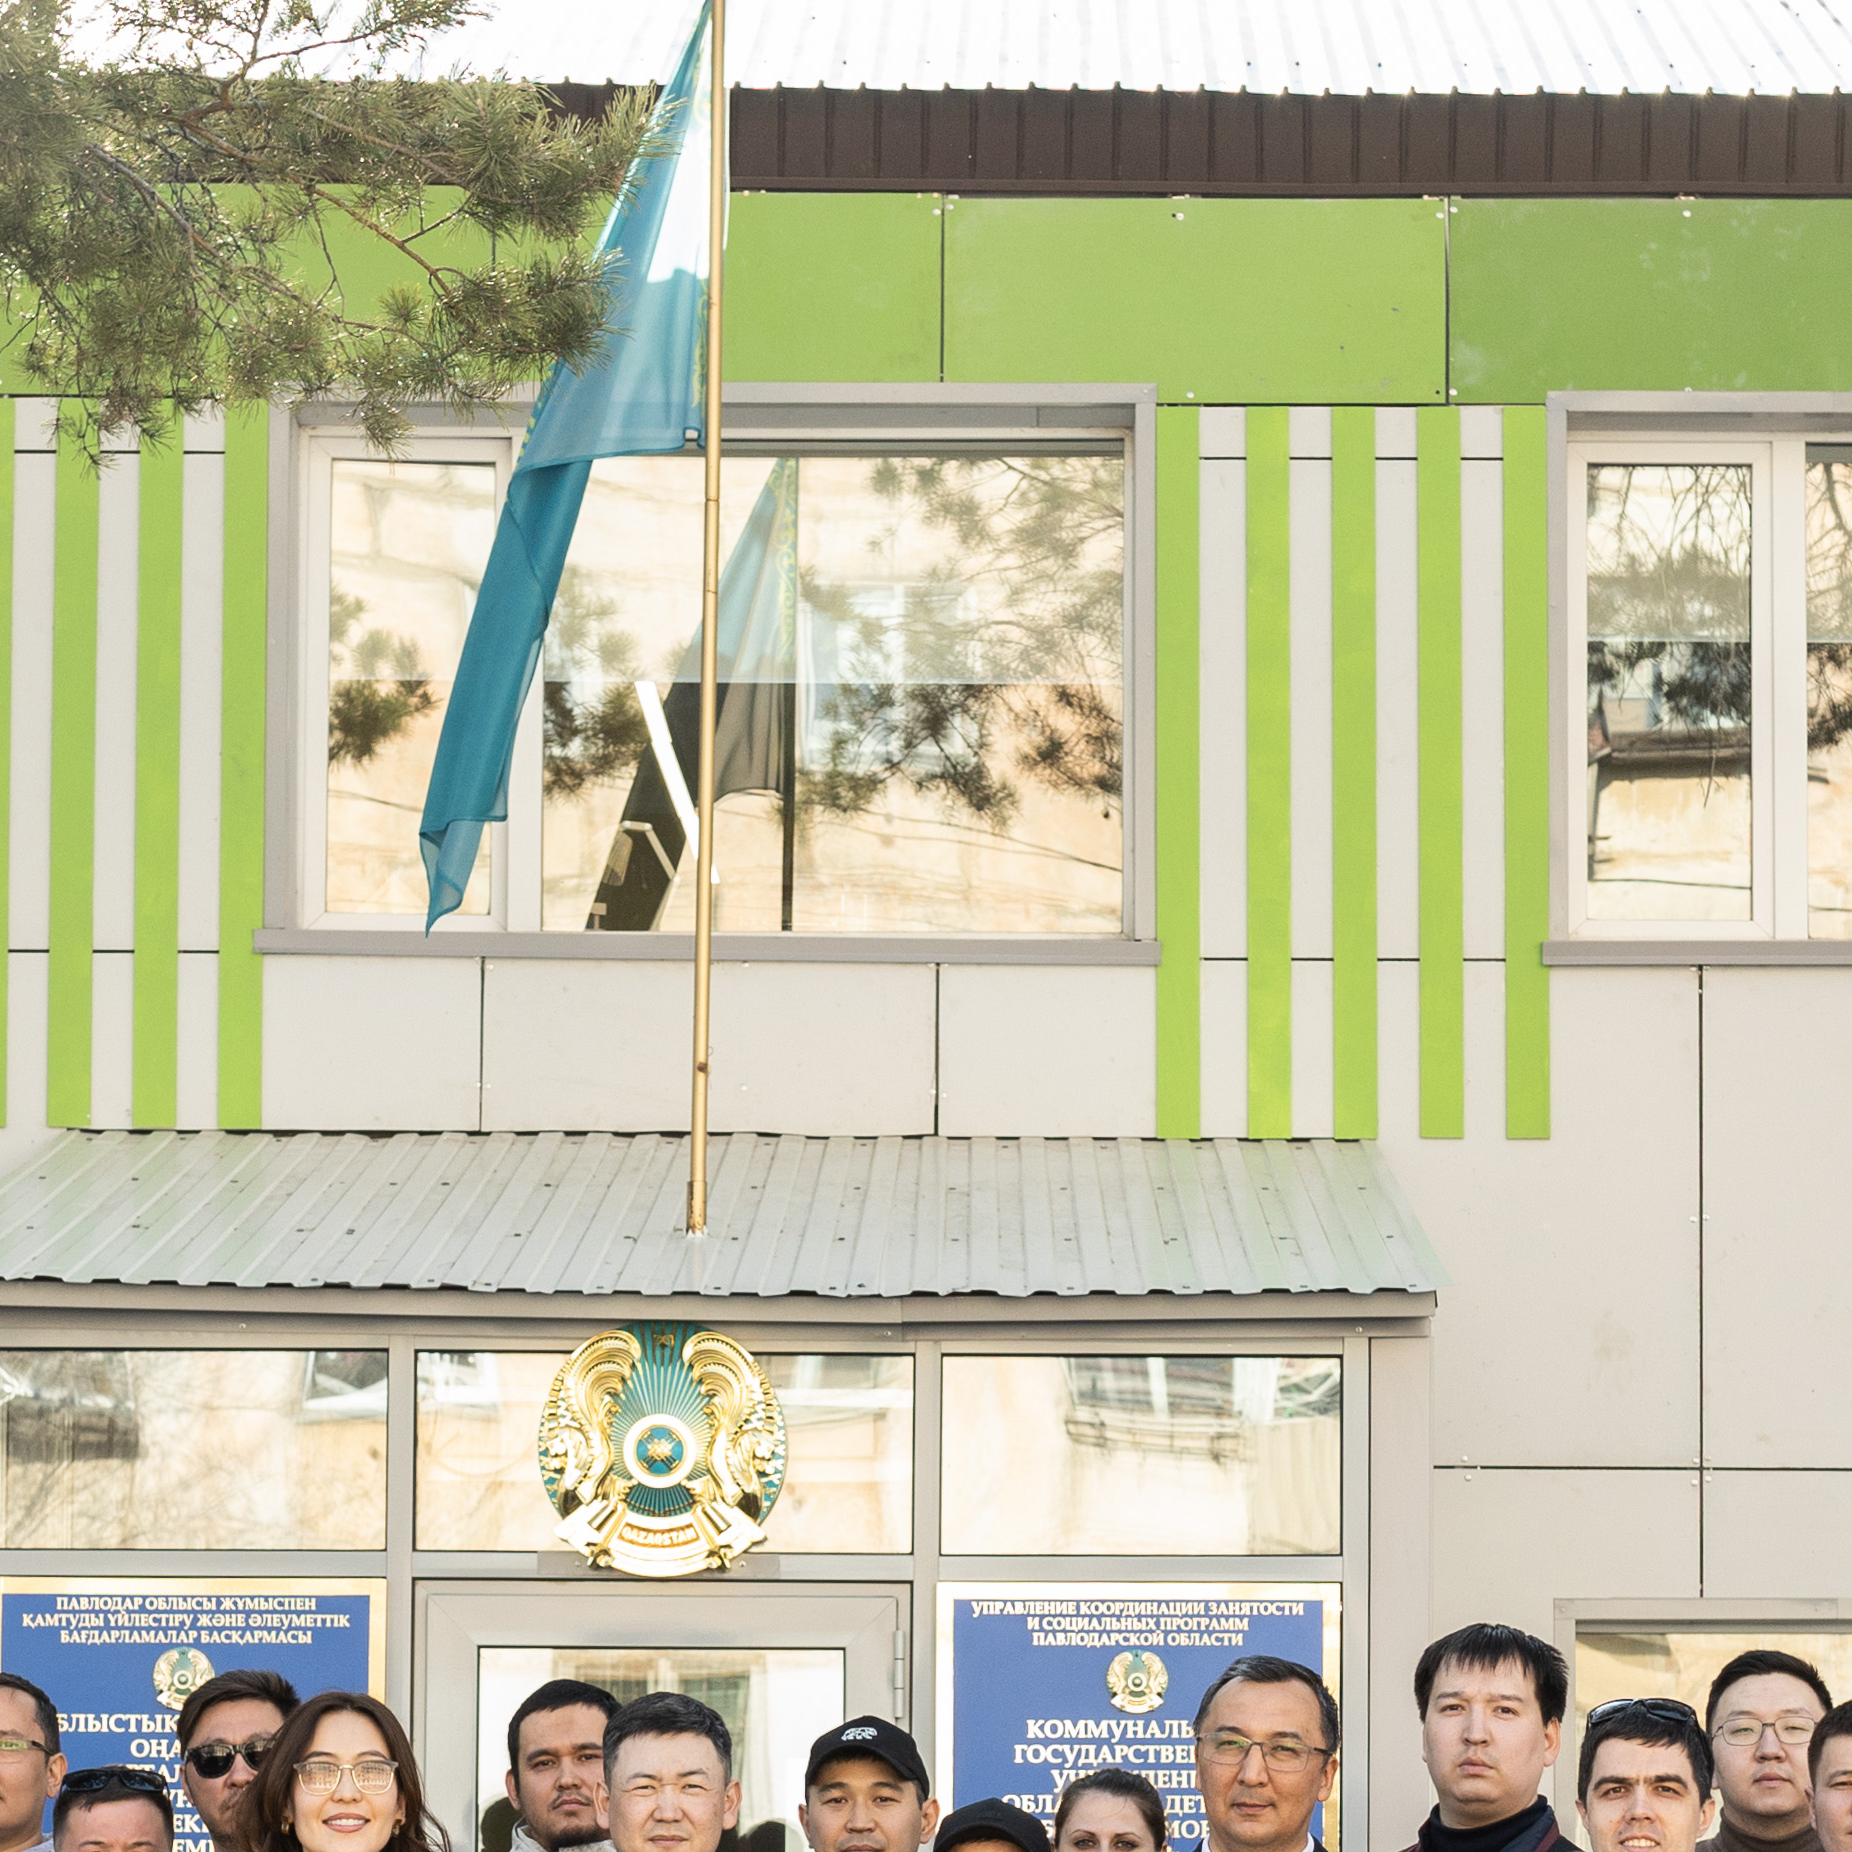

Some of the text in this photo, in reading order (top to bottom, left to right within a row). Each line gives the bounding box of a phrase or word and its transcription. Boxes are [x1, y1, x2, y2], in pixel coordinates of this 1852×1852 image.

[621, 1526, 697, 1546] QAZAQSTAN
[56, 1597, 317, 1613] ПАВЛОДАР ОБЛЫСЫ ЖҰМЫСПЕН
[971, 1601, 1305, 1617] УПРАВЛЕНИЕ КООРДИНАЦИИ ЗАНЯТОСТИ
[22, 1611, 351, 1629] ҚАМТУДЫ ҮЙЛЕСТІРУ ЖӘНЕ ӘЛЕУМЕТТІК
[1027, 1617, 1249, 1632] И СОЦИАЛЬНЫХ ПРОГРАММ
[60, 1629, 312, 1645] БАҒДАРЛАМАЛАР БАСҚАРМАСЫ
[1032, 1630, 1244, 1648] ПАВЛОДАРСКОЙ ОБЛАСТИ
[1026, 1719, 1195, 1743] КОММУНАЛЬ
[130, 1738, 182, 1761] ОҢА
